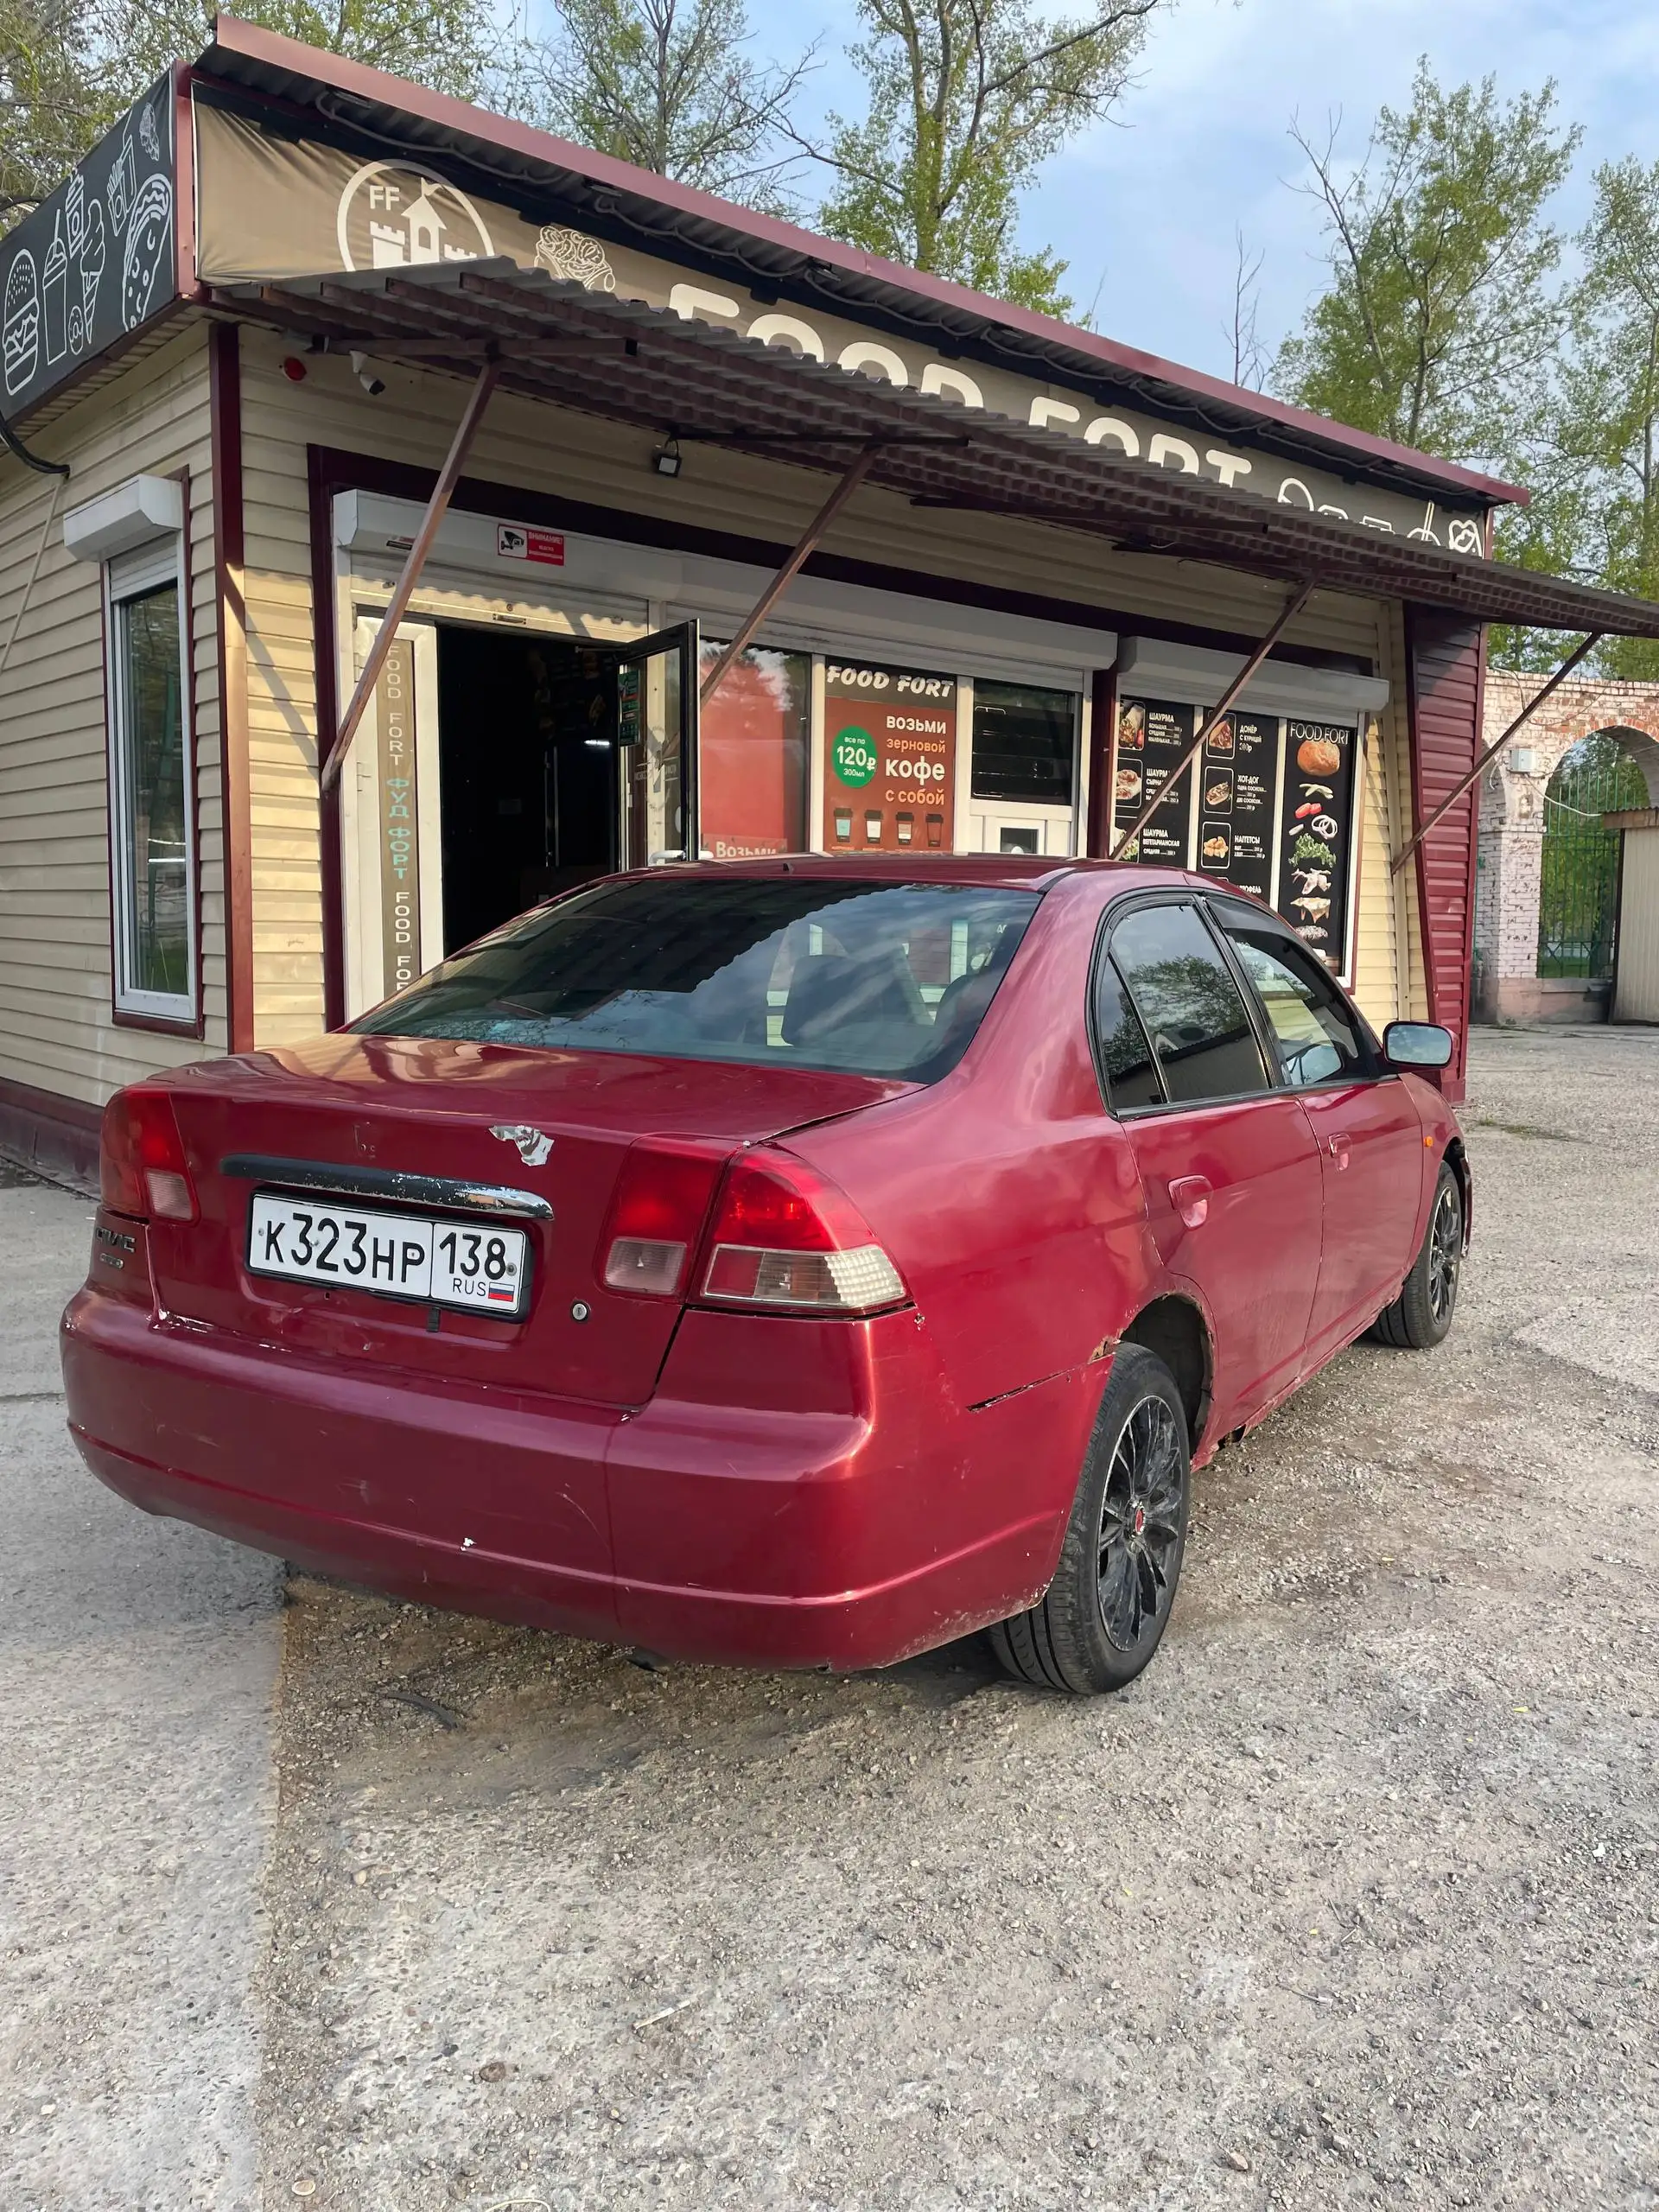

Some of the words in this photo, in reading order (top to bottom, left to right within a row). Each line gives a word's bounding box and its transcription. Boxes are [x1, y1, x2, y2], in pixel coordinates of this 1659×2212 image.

[370, 185, 399, 210] FF
[827, 665, 890, 690] FOOD
[897, 675, 954, 697] FORT
[887, 715, 946, 734] возьми
[1149, 712, 1174, 722] ШАУРМА
[389, 712, 404, 766] FORT
[1290, 721, 1322, 741] FOOD
[1324, 727, 1350, 745] FORT
[887, 738, 946, 753] зерновой
[885, 755, 945, 785] кофе
[1147, 768, 1170, 778] ШАУРМ
[386, 778, 410, 818] ФУД
[898, 788, 944, 805] собой
[1143, 828, 1168, 838] ШАУРМА
[388, 826, 410, 880] ФОРТ
[394, 892, 411, 944] FOOD
[439, 1231, 506, 1280] 138
[453, 1277, 486, 1297] RUS
